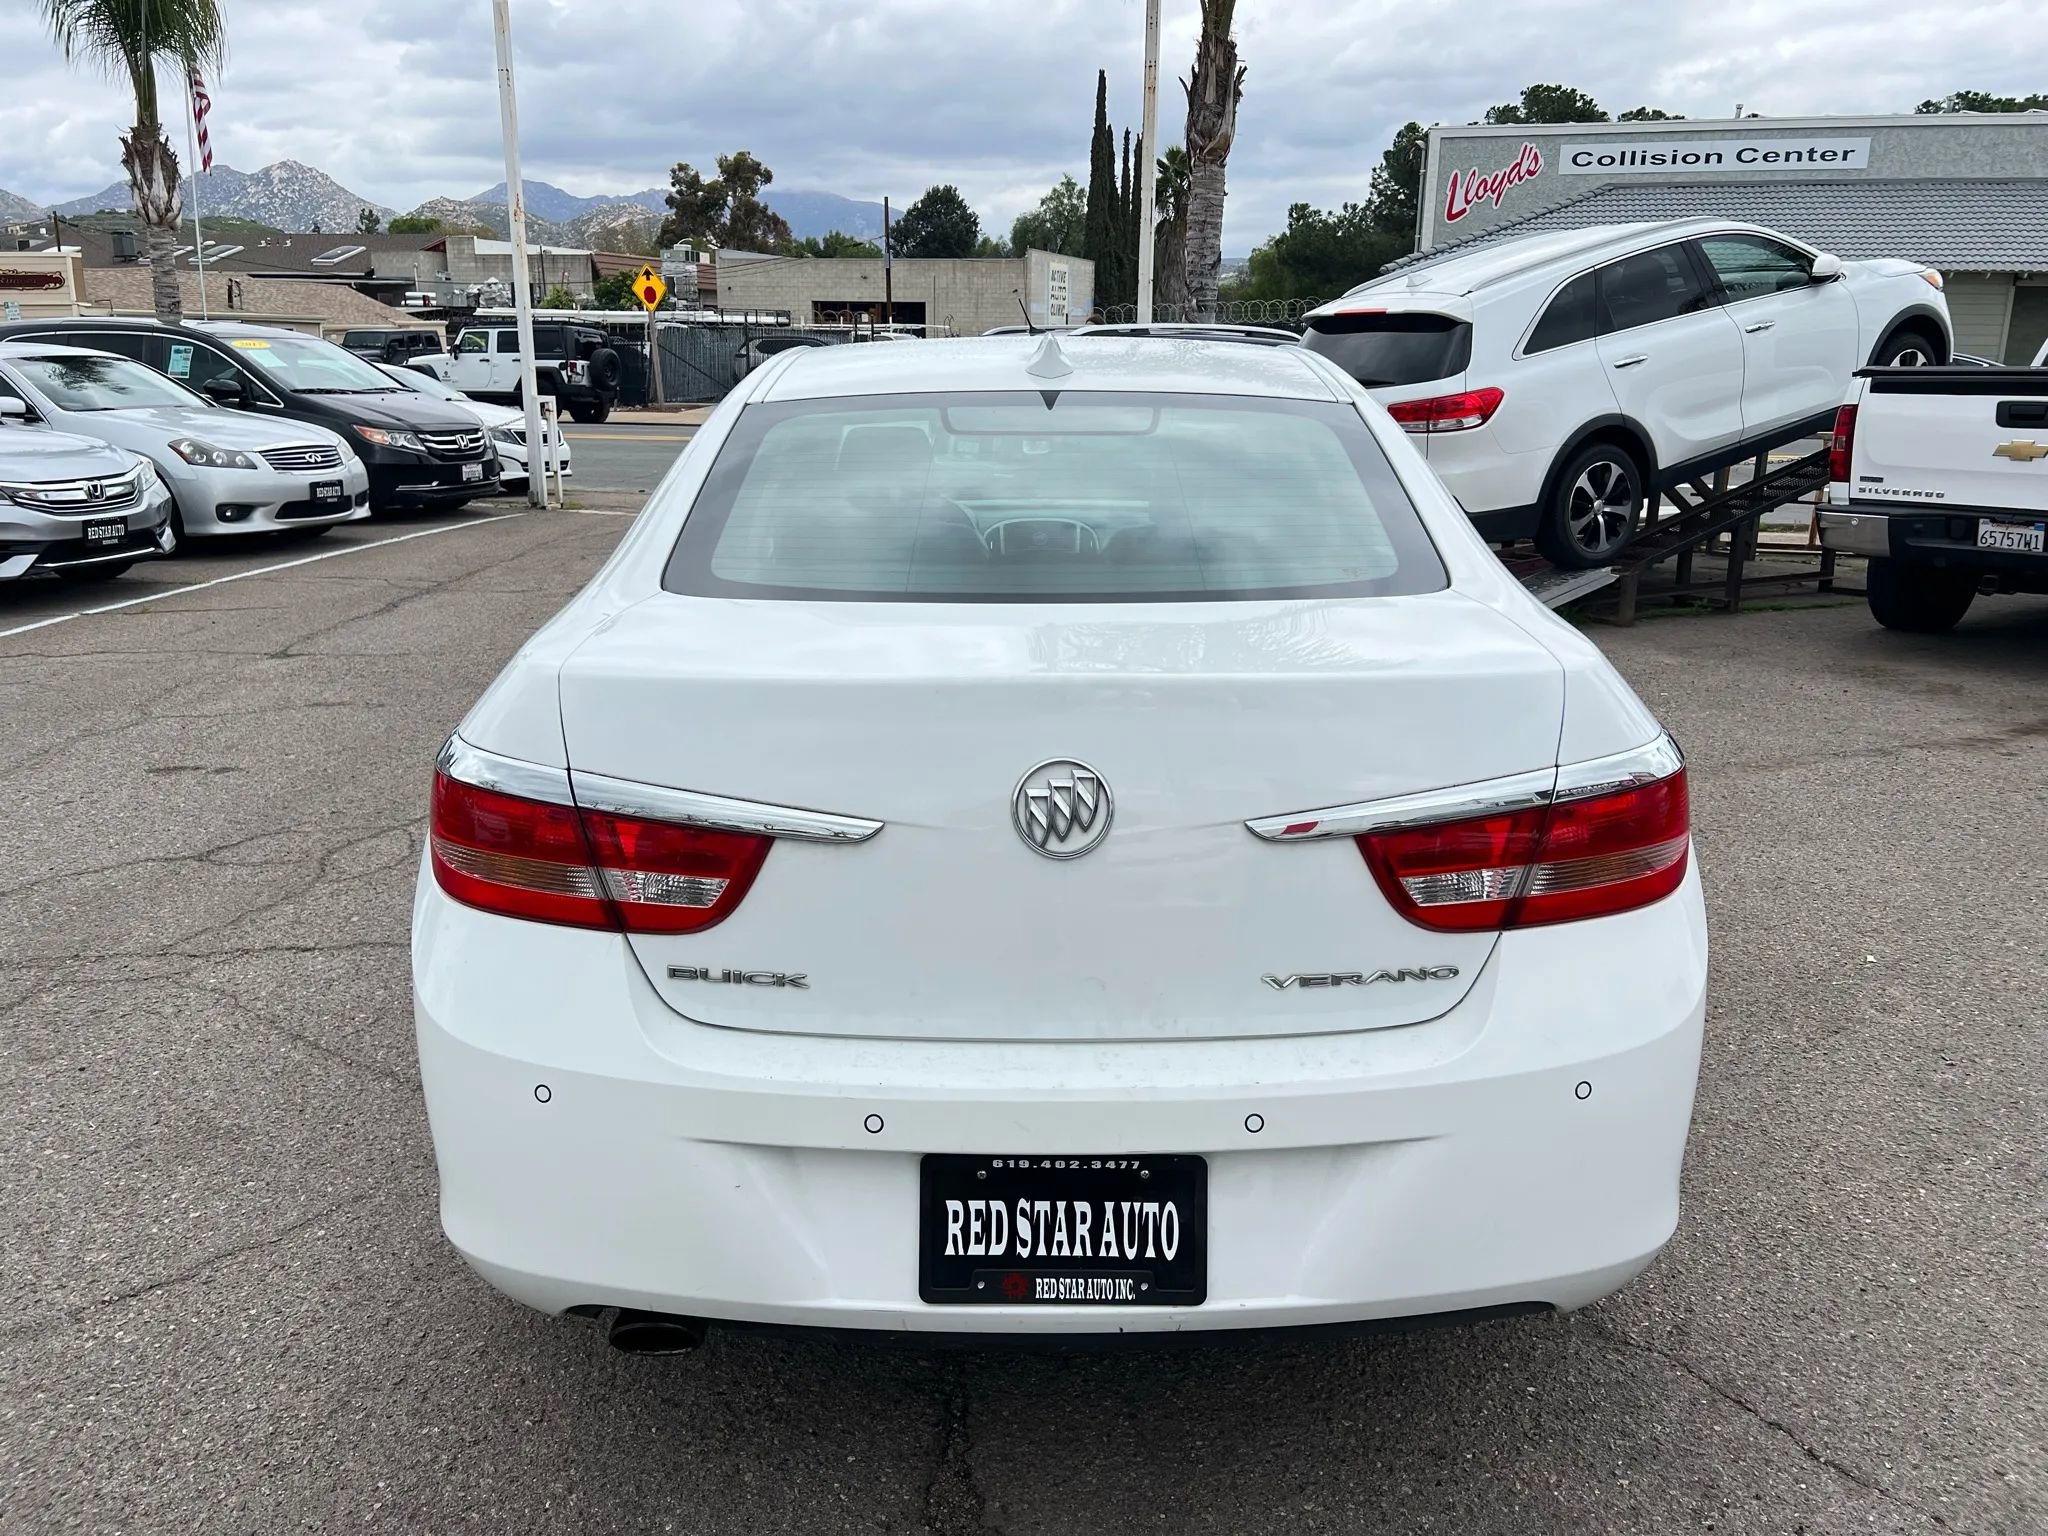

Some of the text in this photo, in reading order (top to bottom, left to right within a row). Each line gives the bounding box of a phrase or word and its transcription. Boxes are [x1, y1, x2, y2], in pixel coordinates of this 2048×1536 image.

[1571, 146, 1856, 168] Collision Center
[1445, 143, 1543, 222] Lloyd's
[1050, 269, 1067, 284] ACTIVE
[1050, 285, 1067, 301] AUTO
[1050, 303, 1066, 317] CLINIC
[1858, 486, 1945, 499] SILVERADO
[87, 523, 125, 540] RED STAR AUTO
[1980, 529, 2041, 551] 65757W1
[667, 964, 810, 990] BUICK
[1260, 964, 1460, 990] VERANO
[992, 1159, 1140, 1169] 619.402.3477
[944, 1197, 1180, 1261] RED STAR AUTO
[1035, 1277, 1136, 1300] RED STAR AUTO INC.
